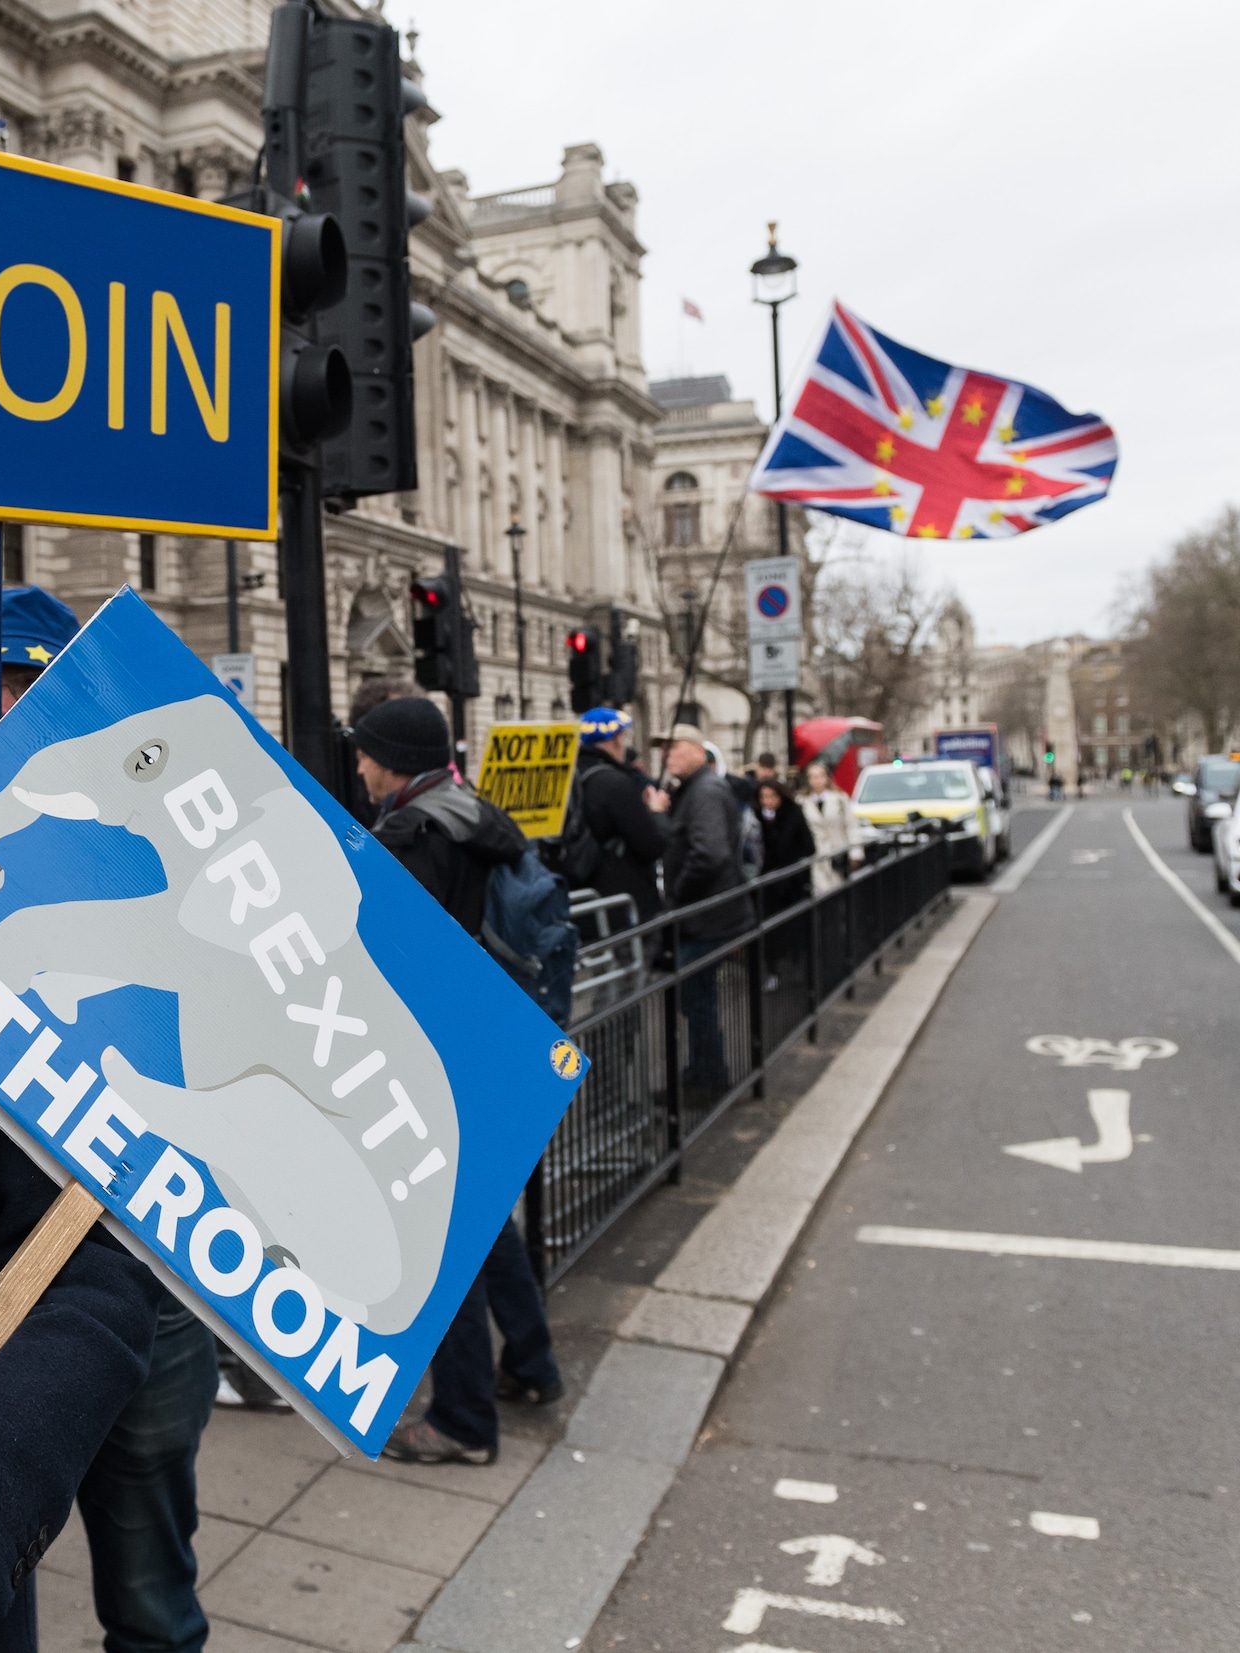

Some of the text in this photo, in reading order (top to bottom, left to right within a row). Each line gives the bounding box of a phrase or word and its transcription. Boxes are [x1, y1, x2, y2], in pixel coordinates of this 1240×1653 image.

[488, 733, 575, 762] NOT MY
[163, 768, 447, 1201] BREXIT!
[125, 1145, 400, 1437] ROOM
